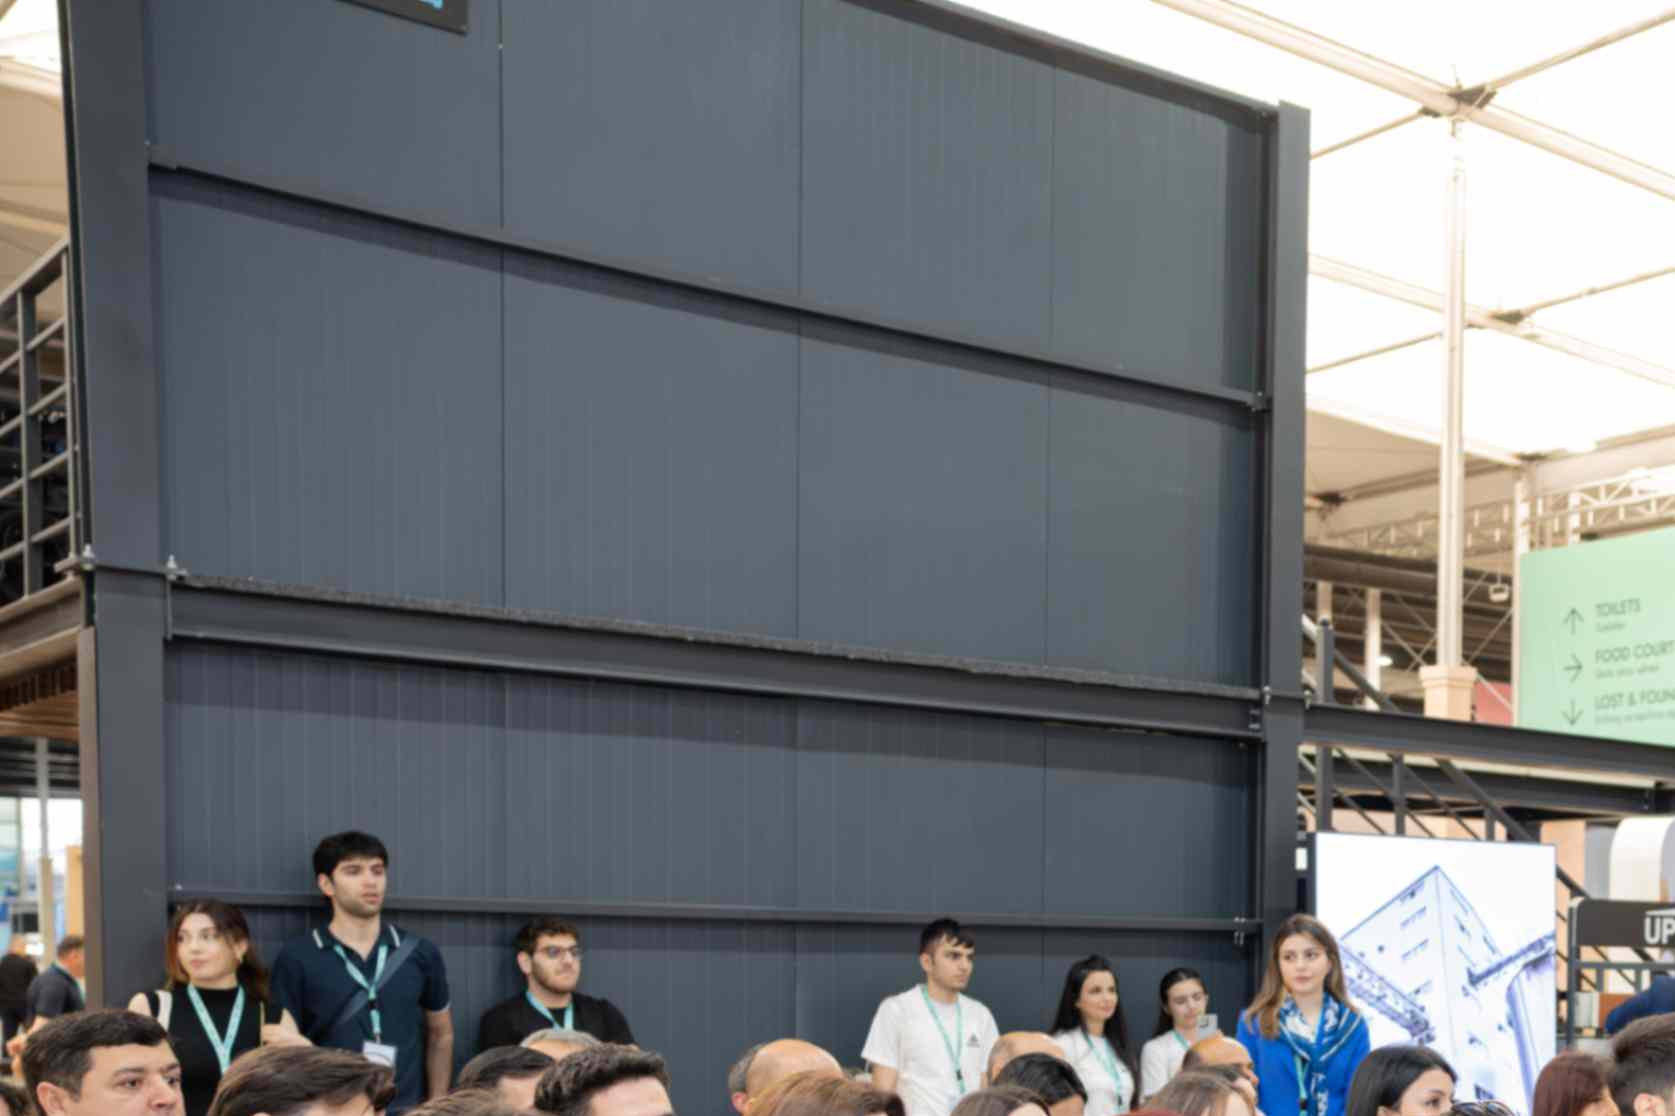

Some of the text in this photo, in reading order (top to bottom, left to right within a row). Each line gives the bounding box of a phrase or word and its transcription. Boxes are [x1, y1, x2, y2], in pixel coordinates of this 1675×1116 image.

[1595, 598, 1641, 616] TOILETS
[1595, 640, 1675, 664] FOOD COURT
[1595, 692, 1624, 710] LOST
